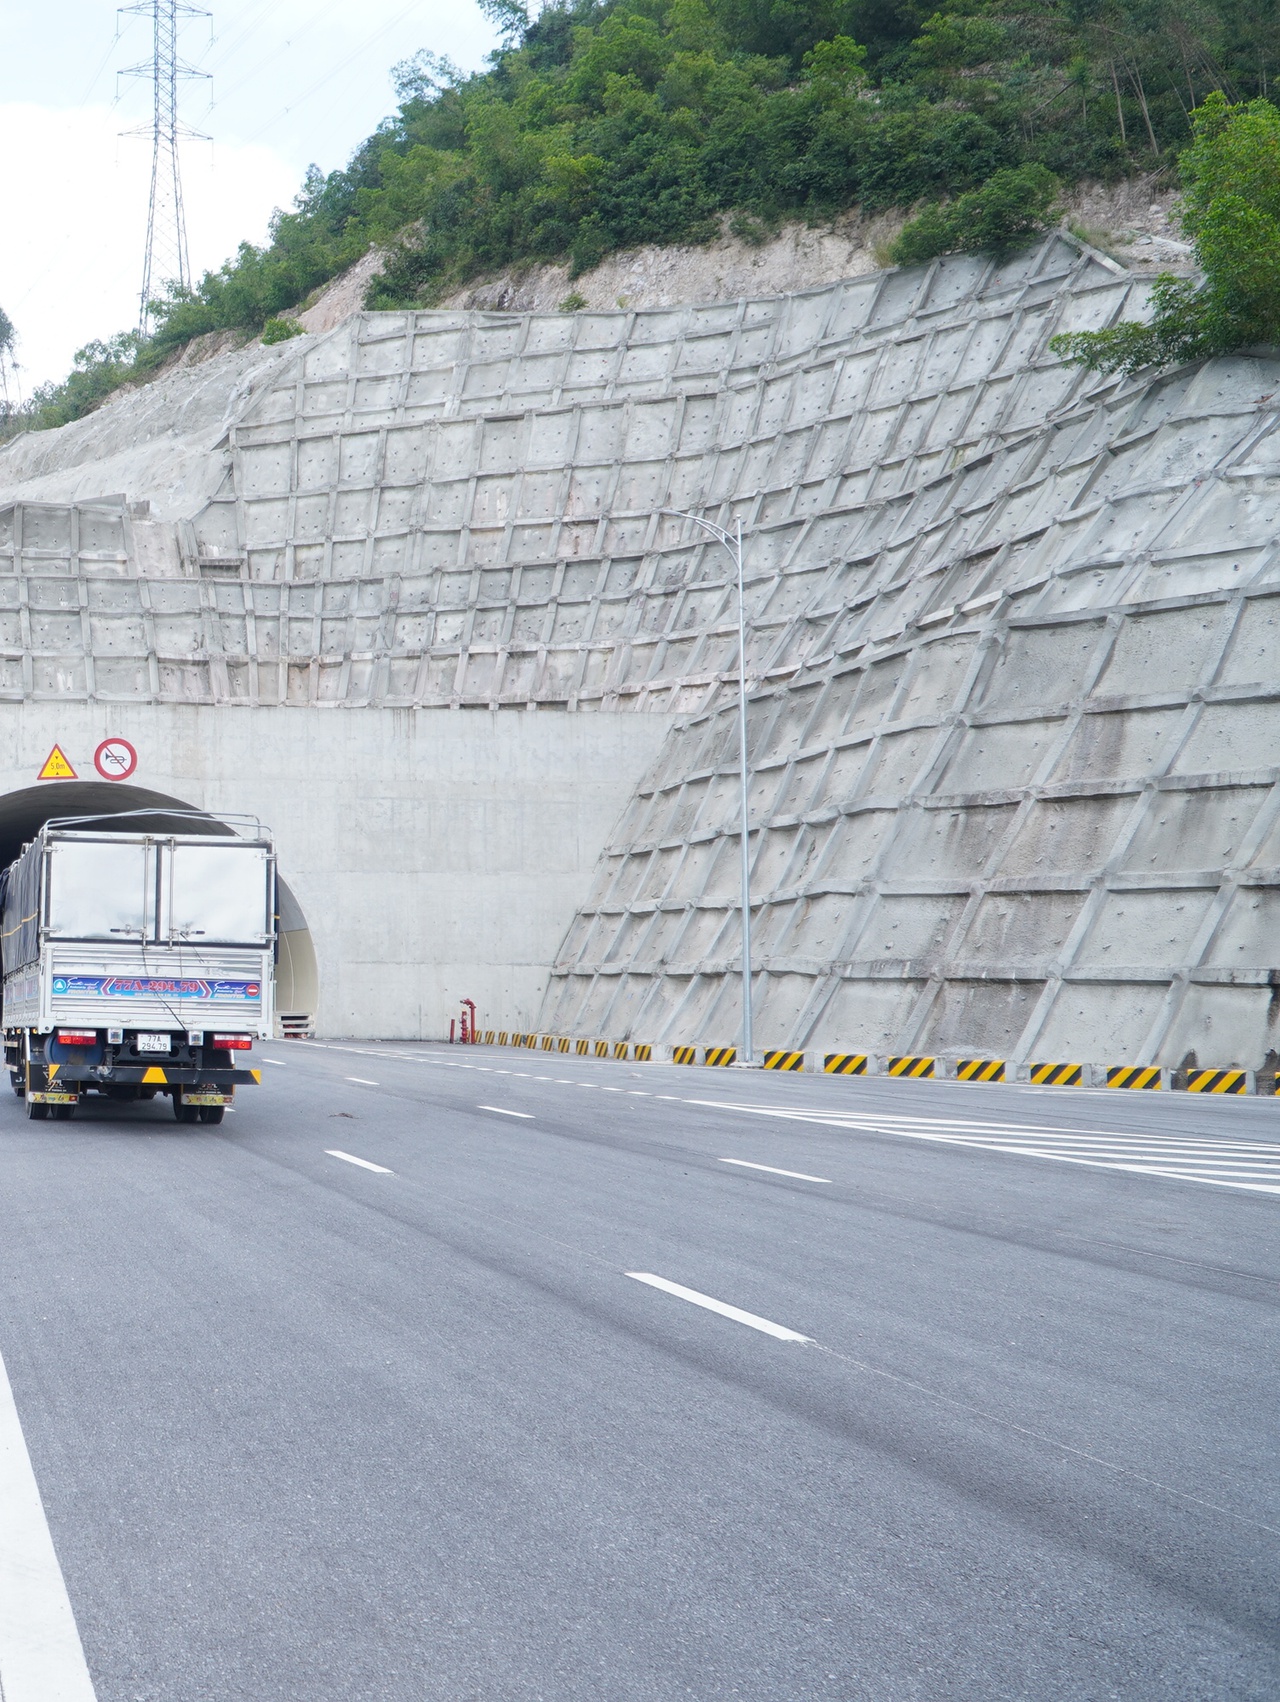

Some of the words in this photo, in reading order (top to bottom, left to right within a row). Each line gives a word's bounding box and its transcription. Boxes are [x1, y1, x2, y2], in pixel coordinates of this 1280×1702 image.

[50, 762, 65, 770] 5.0m
[114, 979, 199, 993] 77A-294.79
[141, 1042, 168, 1050] 294.79
